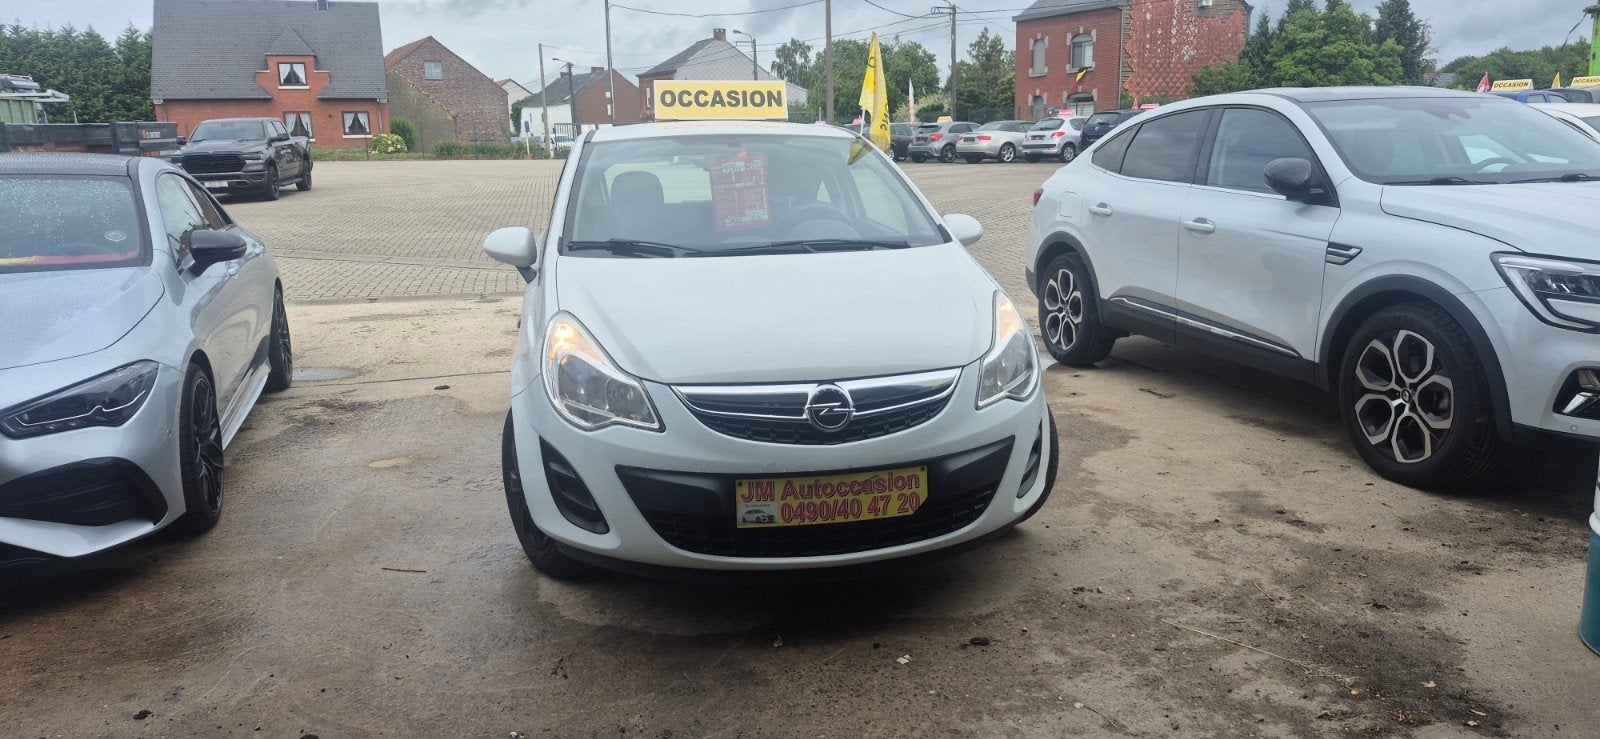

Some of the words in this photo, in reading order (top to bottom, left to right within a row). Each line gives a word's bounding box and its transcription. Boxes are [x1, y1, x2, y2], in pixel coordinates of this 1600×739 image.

[660, 89, 783, 107] OCCASION
[740, 480, 775, 503] JM
[780, 472, 920, 501] Autoccasion
[780, 498, 862, 524] 0490/40
[867, 495, 892, 516] 47
[896, 492, 920, 514] 20
